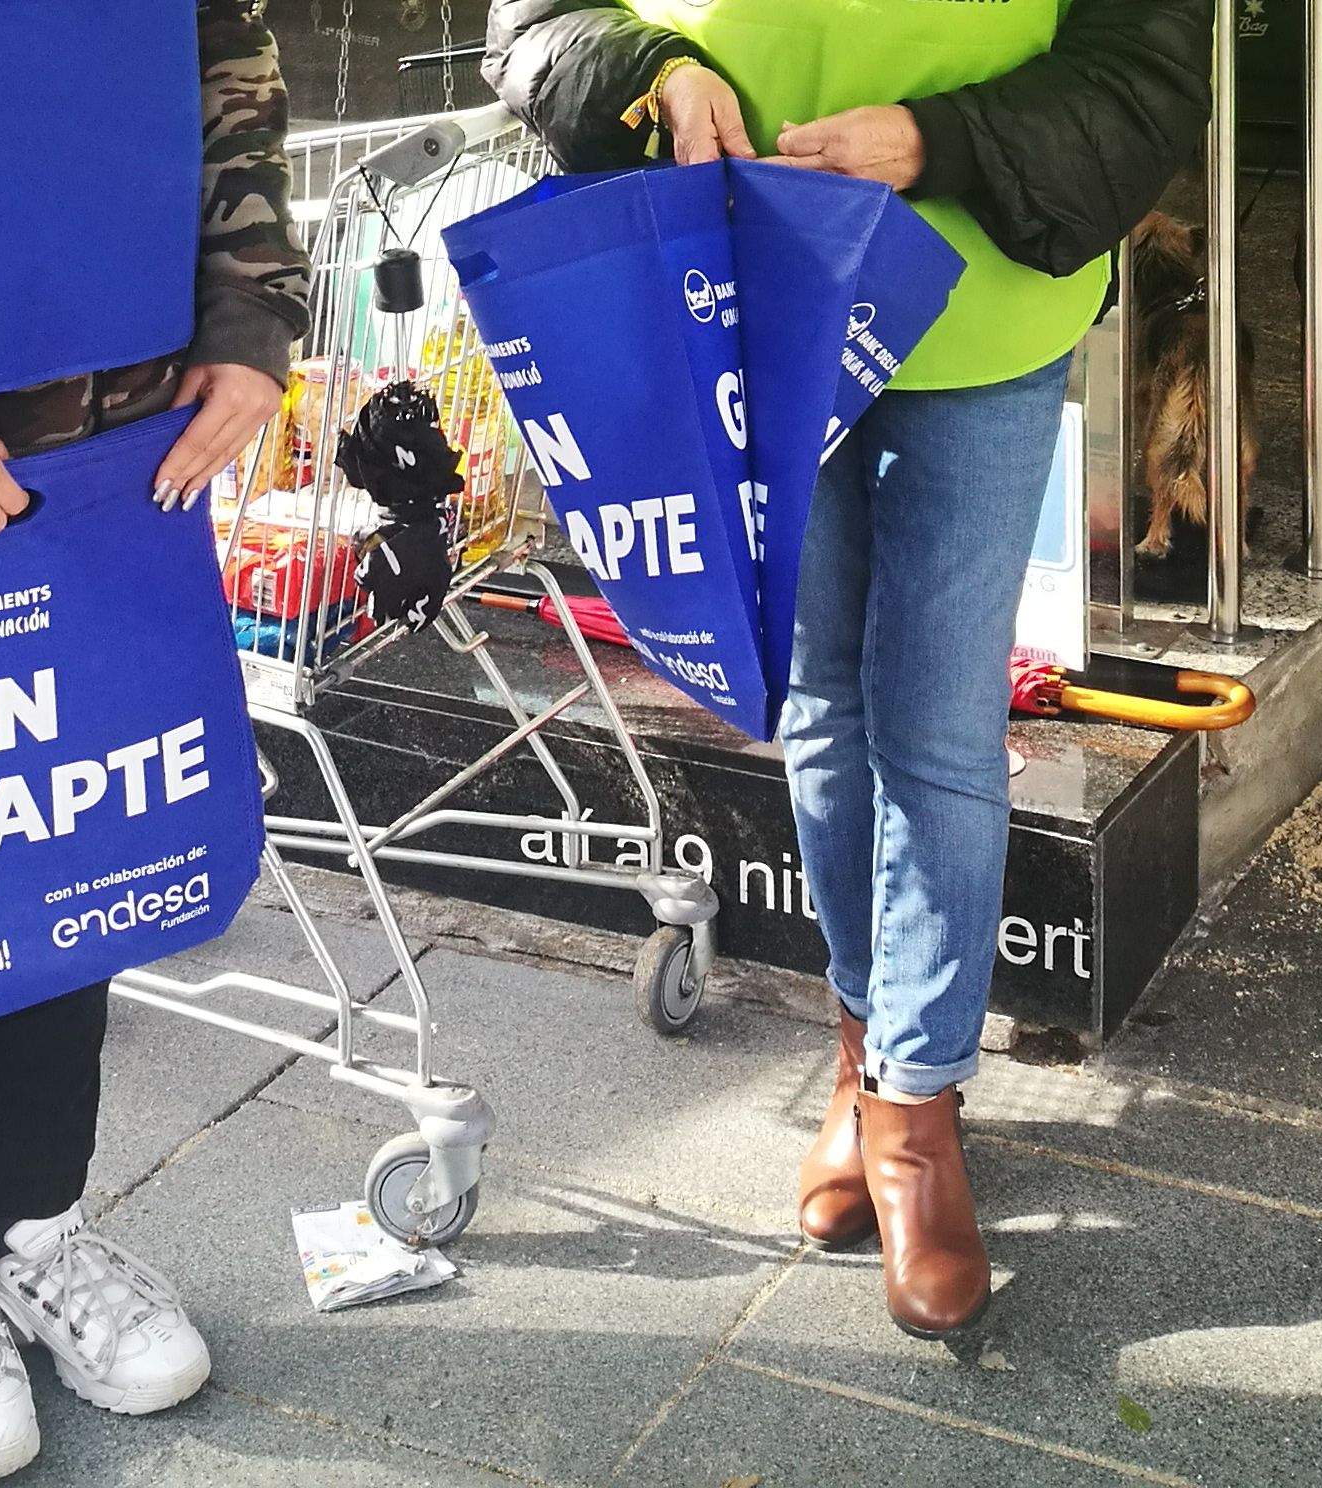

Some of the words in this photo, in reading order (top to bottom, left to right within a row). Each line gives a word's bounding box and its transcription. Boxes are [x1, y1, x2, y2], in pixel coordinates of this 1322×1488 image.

[486, 337, 532, 359] MENTS
[857, 330, 883, 356] BANC
[566, 494, 704, 580] APTE
[45, 887, 72, 904] con
[76, 881, 89, 894] la
[92, 854, 184, 890] colaboración
[52, 872, 210, 948] endesa
[161, 904, 210, 931] Fundación
[998, 916, 1090, 979] ert
